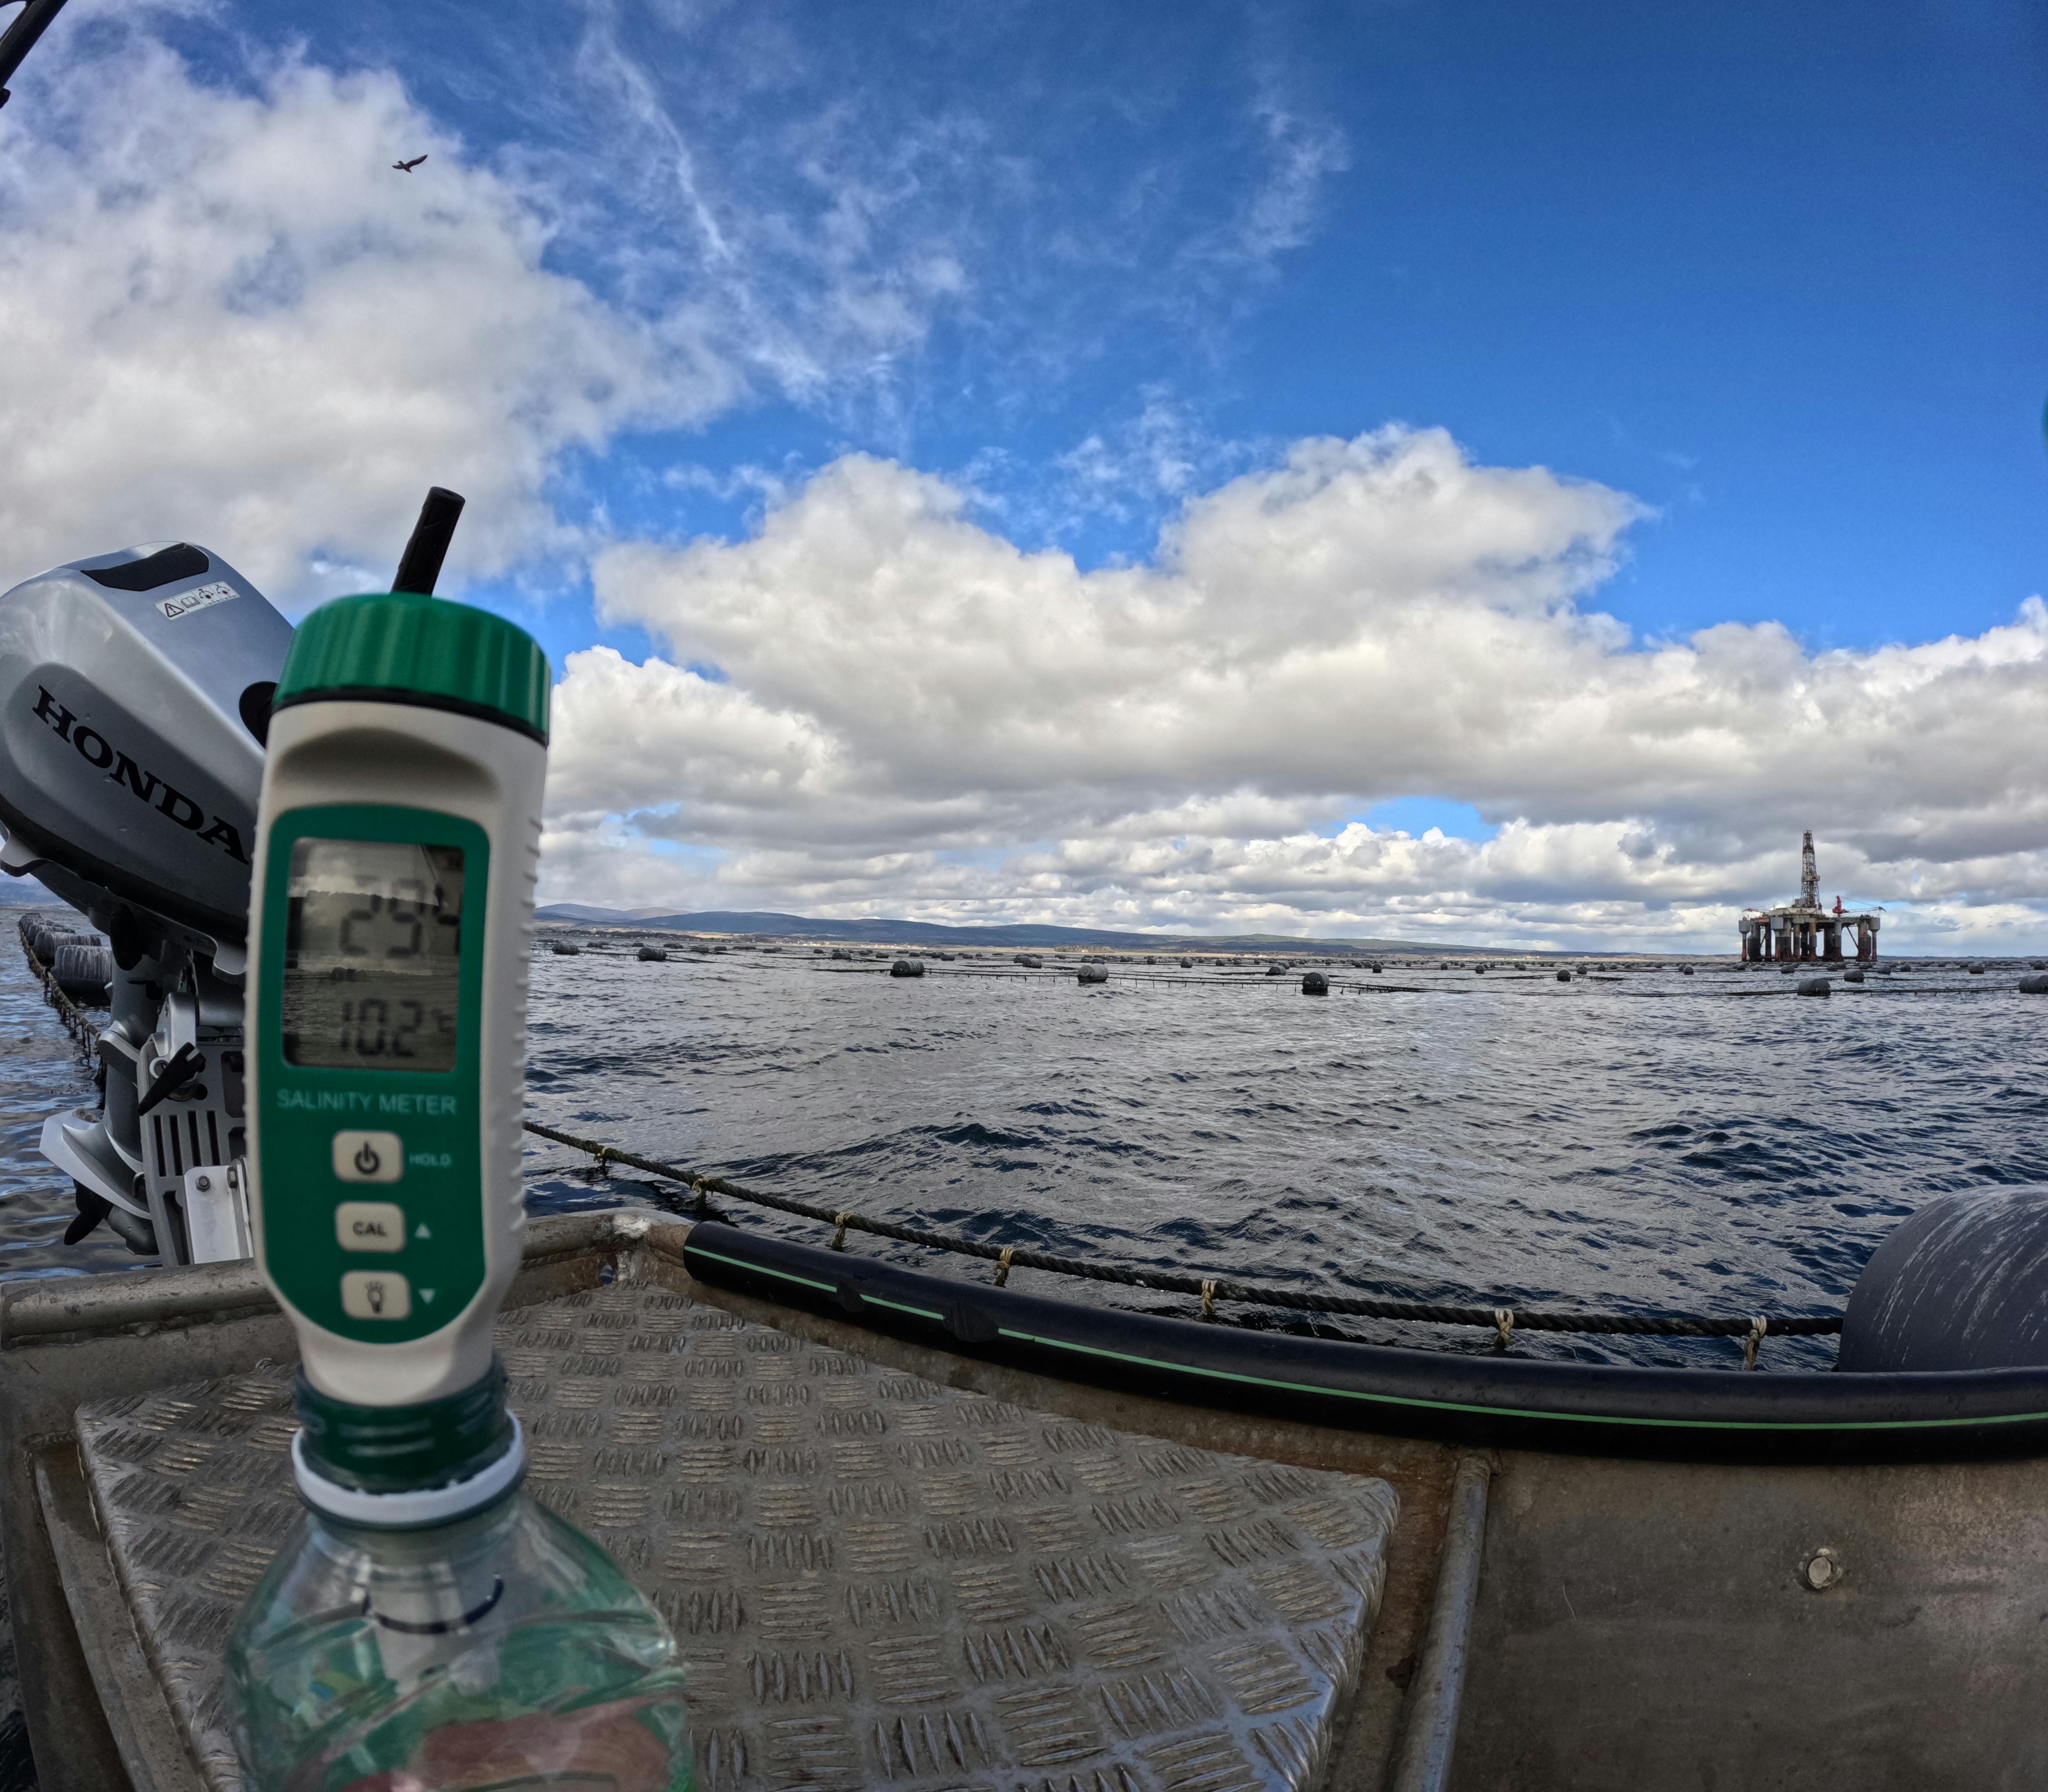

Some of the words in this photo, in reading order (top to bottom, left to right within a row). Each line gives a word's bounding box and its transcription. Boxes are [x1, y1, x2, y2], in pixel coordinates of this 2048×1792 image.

[33, 685, 249, 865] HONDA
[277, 1088, 372, 1111] SALINITY
[379, 1093, 458, 1116] METER
[408, 1153, 453, 1168] HOLD
[352, 1221, 387, 1237] CAL
